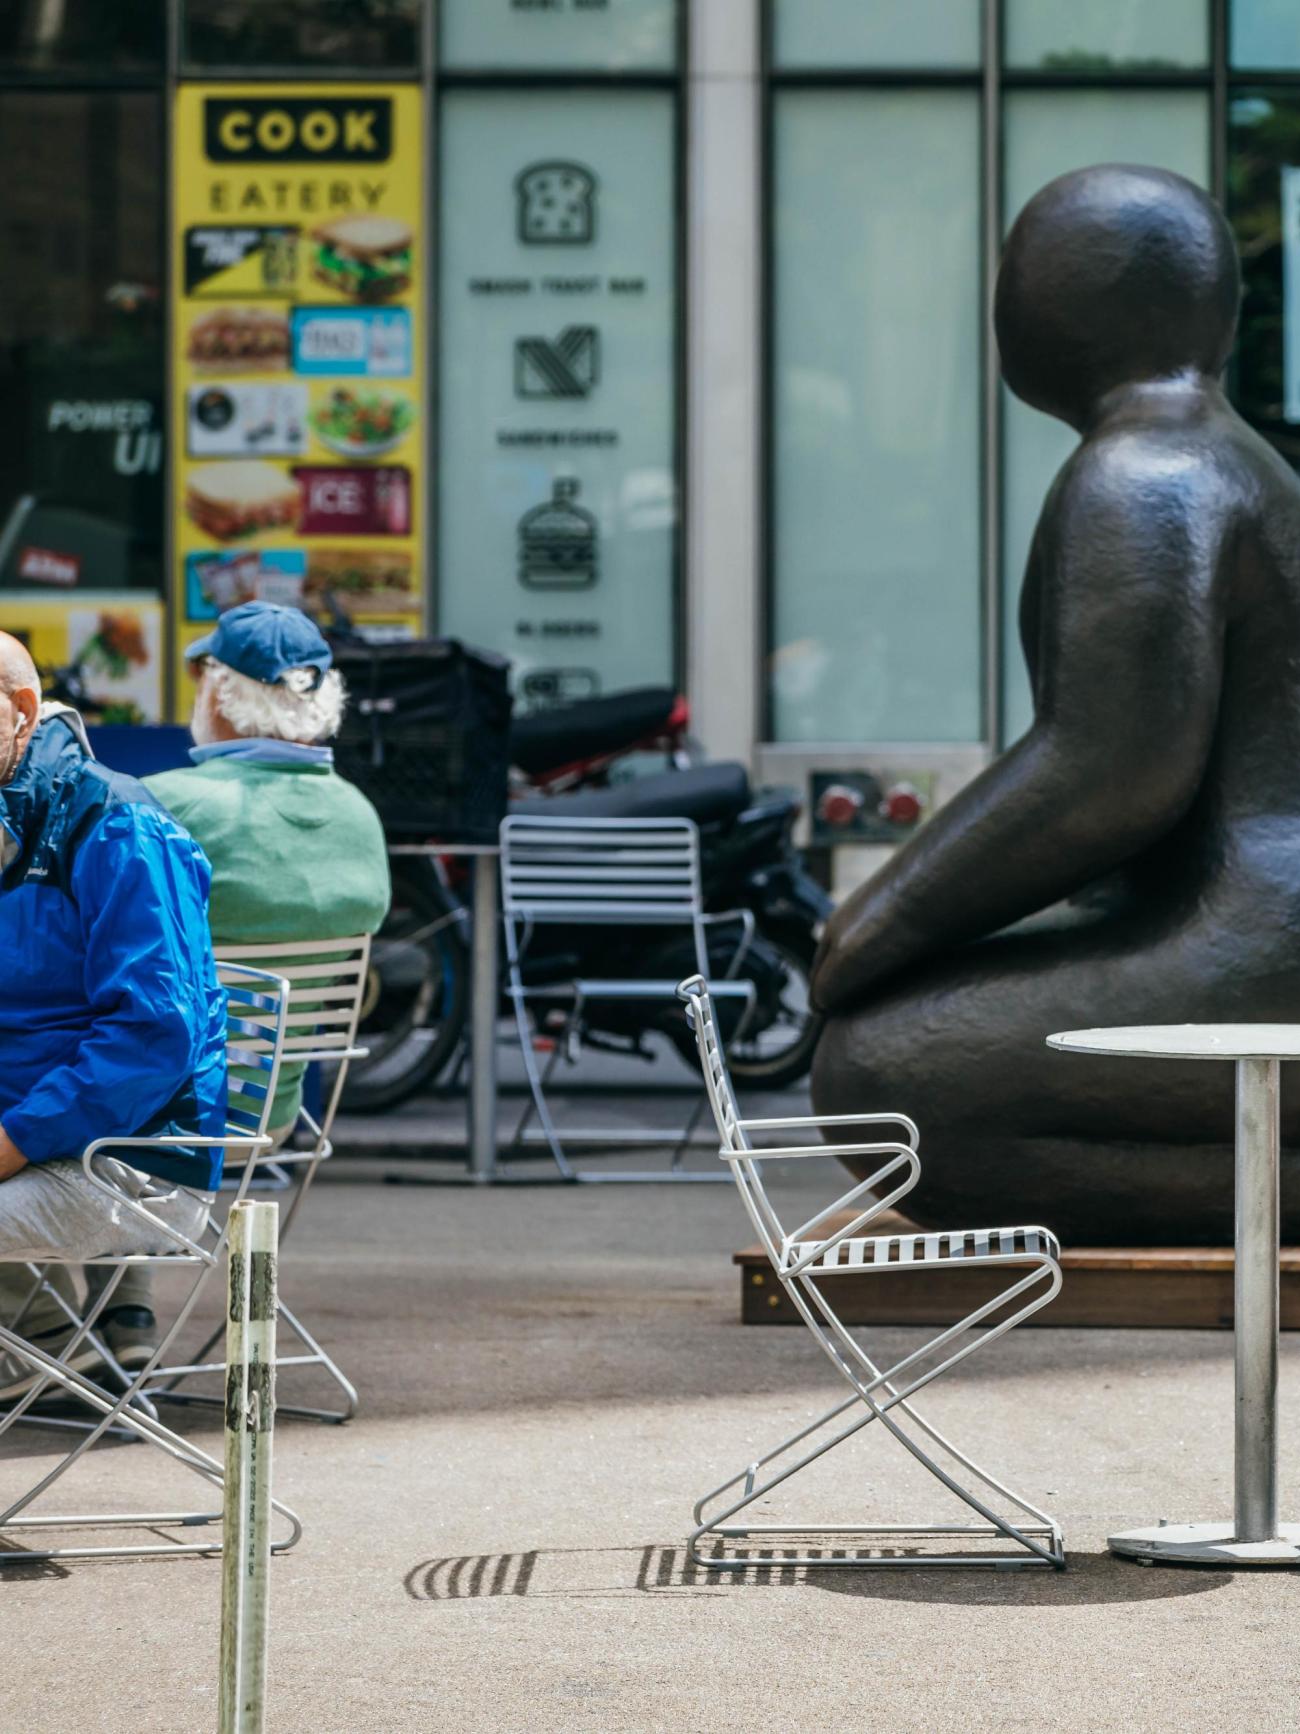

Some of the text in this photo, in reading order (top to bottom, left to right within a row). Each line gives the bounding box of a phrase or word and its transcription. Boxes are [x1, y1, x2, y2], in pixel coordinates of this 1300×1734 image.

[220, 111, 379, 151] COOK
[210, 183, 388, 213] EATERY
[49, 401, 152, 432] POWER
